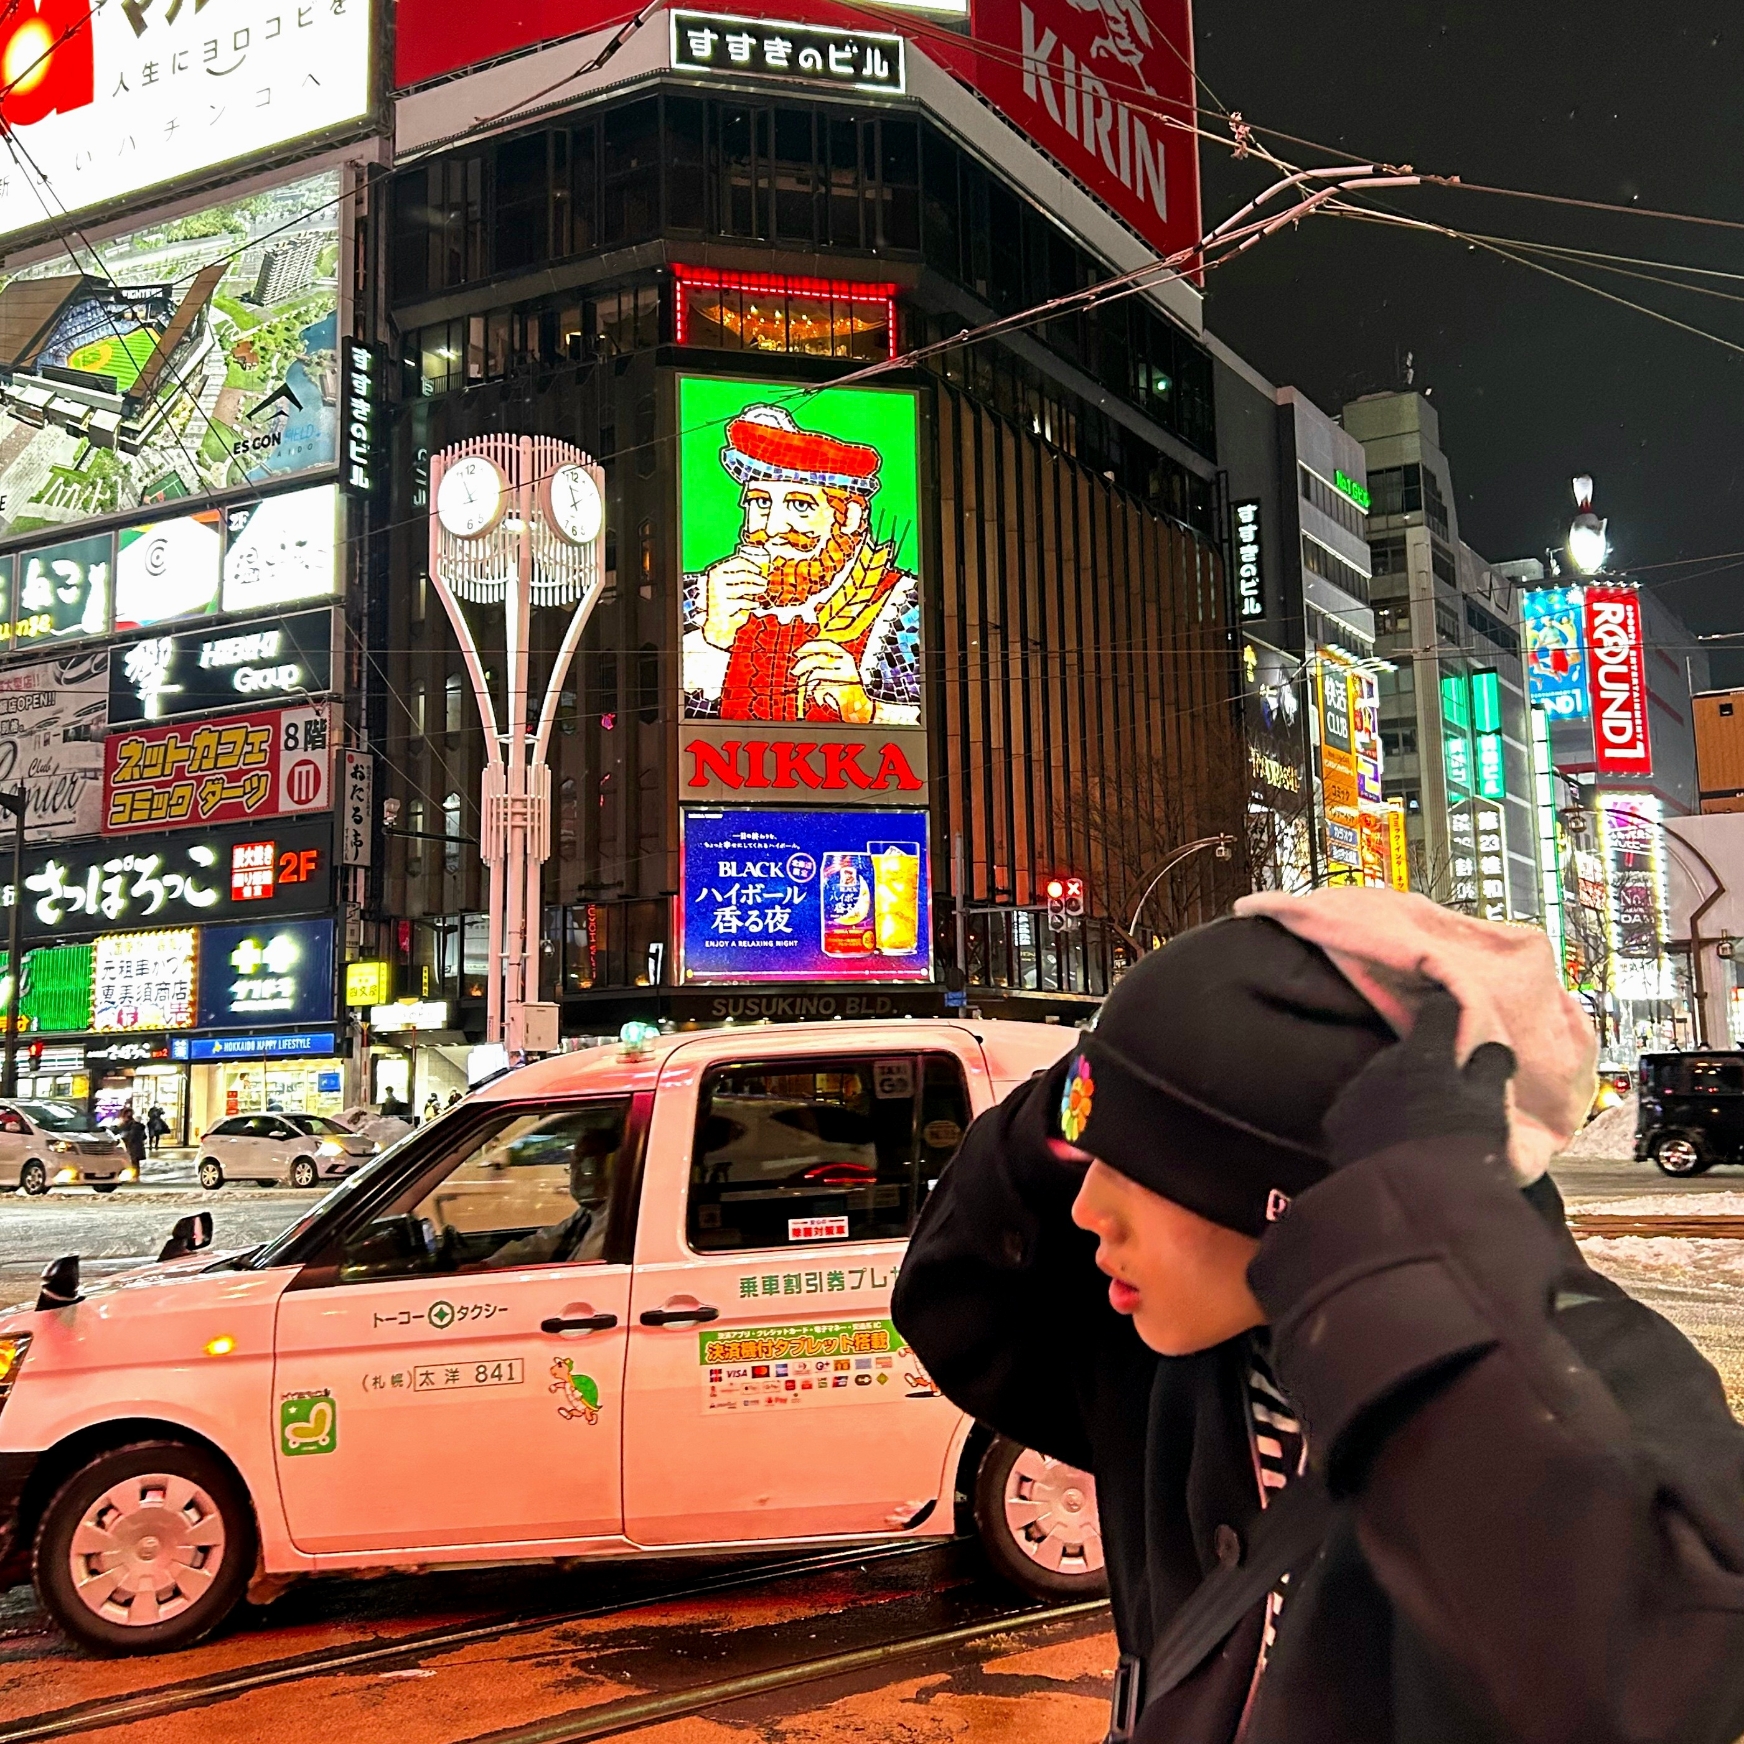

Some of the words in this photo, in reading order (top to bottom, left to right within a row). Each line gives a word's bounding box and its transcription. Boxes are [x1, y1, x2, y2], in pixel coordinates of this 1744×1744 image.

[686, 27, 889, 79] すすきのビル
[1020, 0, 1168, 225] KIRIN
[465, 464, 476, 476] 12
[570, 471, 579, 484] 12
[466, 519, 474, 530] 6
[571, 525, 578, 536] 6
[1237, 502, 1263, 616] すすきのビル
[233, 663, 300, 694] Group
[1592, 601, 1646, 759] ROUND1
[283, 718, 328, 753] 8階
[1326, 711, 1349, 740] CLUB
[113, 725, 272, 786] ネットカフェ
[684, 738, 925, 791] NIKKA
[109, 783, 194, 825] コミック
[200, 773, 271, 817] ダーツ
[279, 849, 318, 884] 2F
[718, 861, 785, 878] BLACK
[24, 844, 219, 926] さっぽろっこ
[694, 882, 808, 906] ハイボール
[710, 904, 794, 934] 香る夜
[705, 940, 730, 948] ENJOY
[730, 940, 737, 948] A
[738, 940, 774, 948] RELAXING
[775, 940, 799, 948] NIGHT
[711, 996, 836, 1017] SUSUKINO
[845, 995, 898, 1017] BLD.
[278, 1038, 311, 1050] LIFESTYLE
[373, 1311, 425, 1329] トーコー
[456, 1303, 509, 1321] タクシー
[474, 1362, 517, 1383] 841
